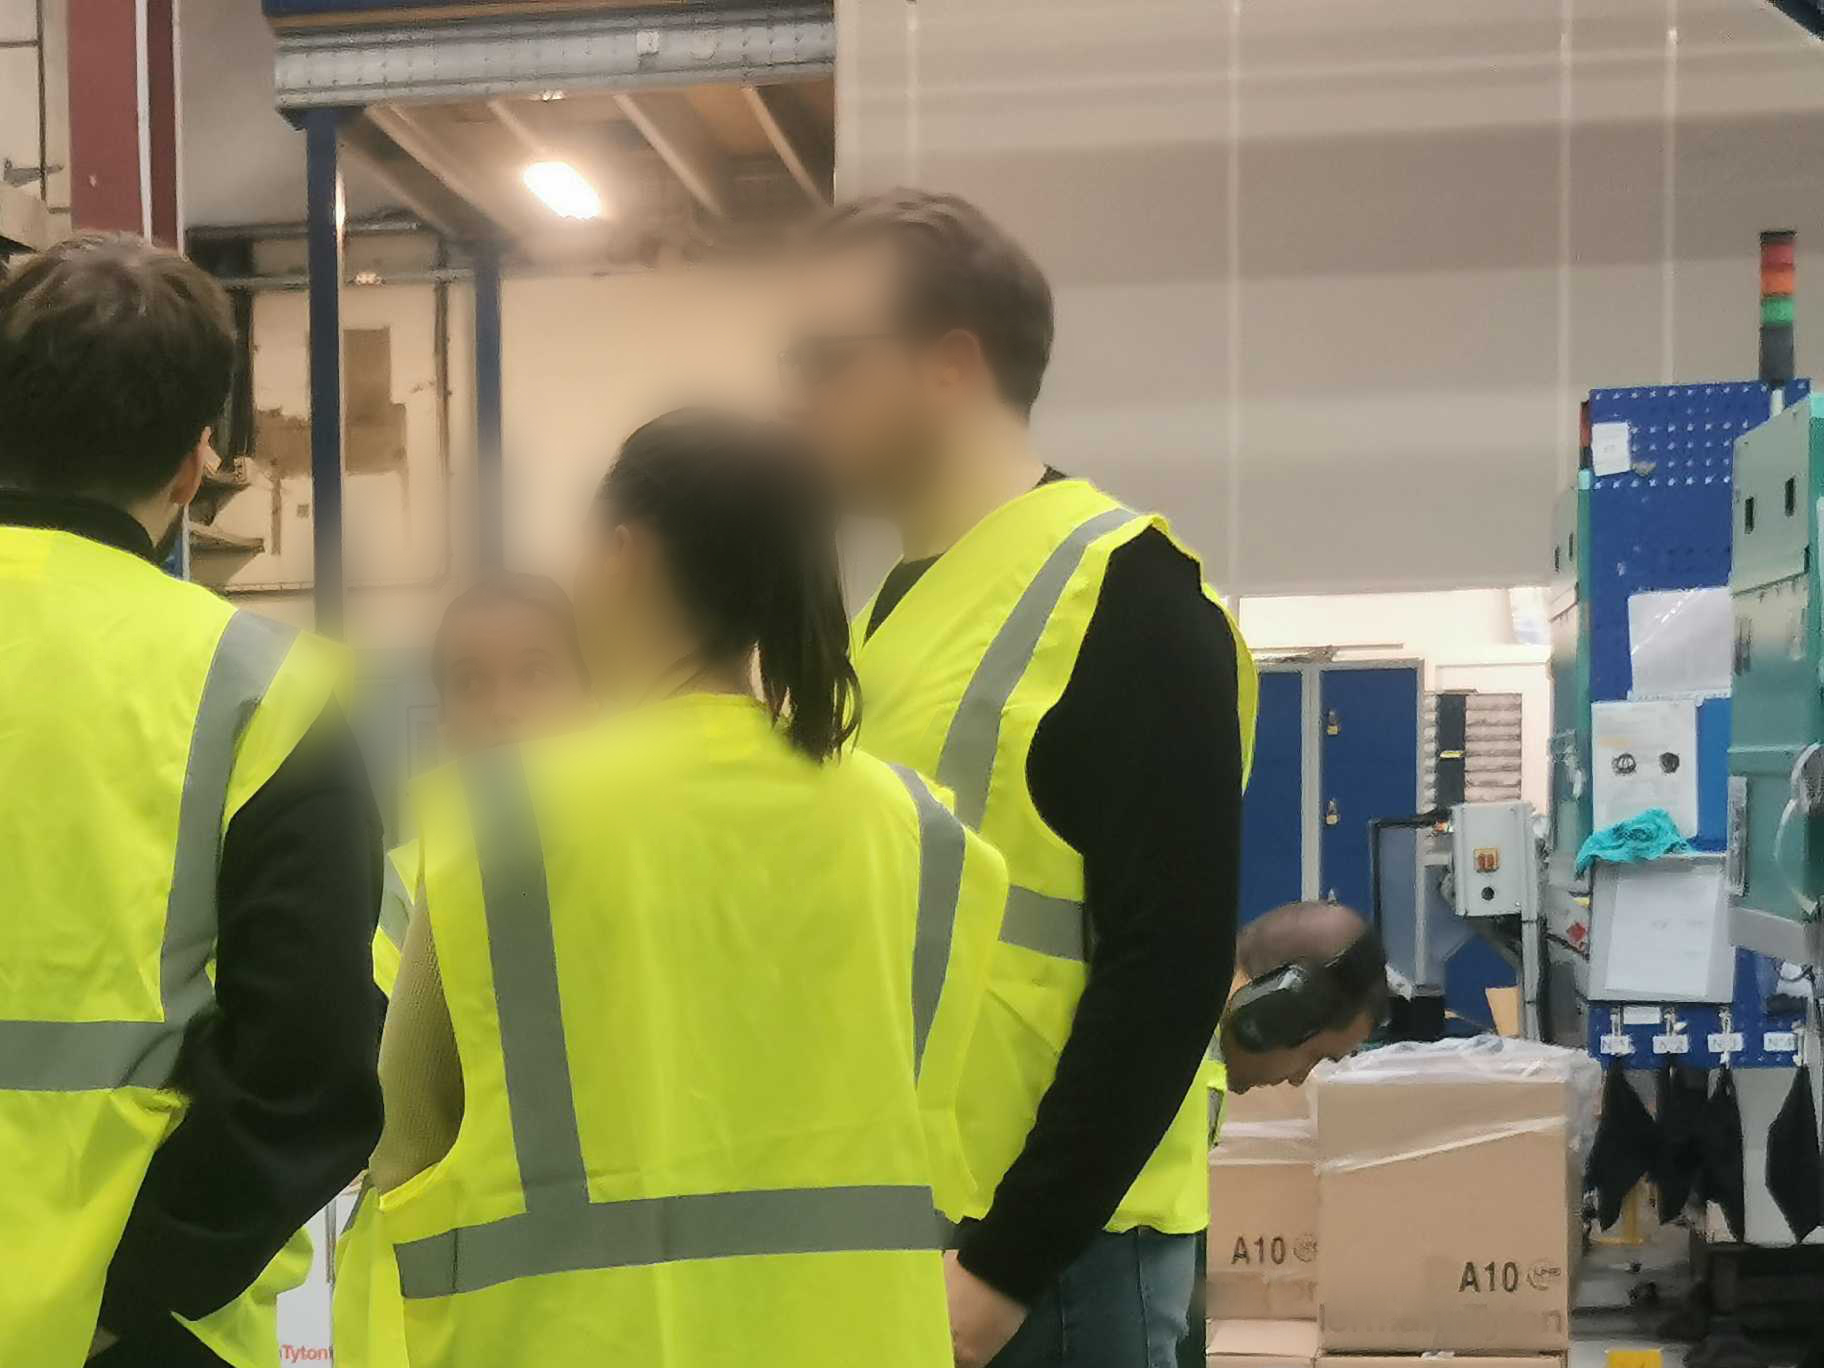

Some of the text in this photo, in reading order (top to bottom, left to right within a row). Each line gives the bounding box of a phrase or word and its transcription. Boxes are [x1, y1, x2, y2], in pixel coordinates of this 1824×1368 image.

[1230, 1235, 1286, 1265] A10
[1457, 1261, 1519, 1293] A10
[279, 1344, 328, 1364] Tyton
